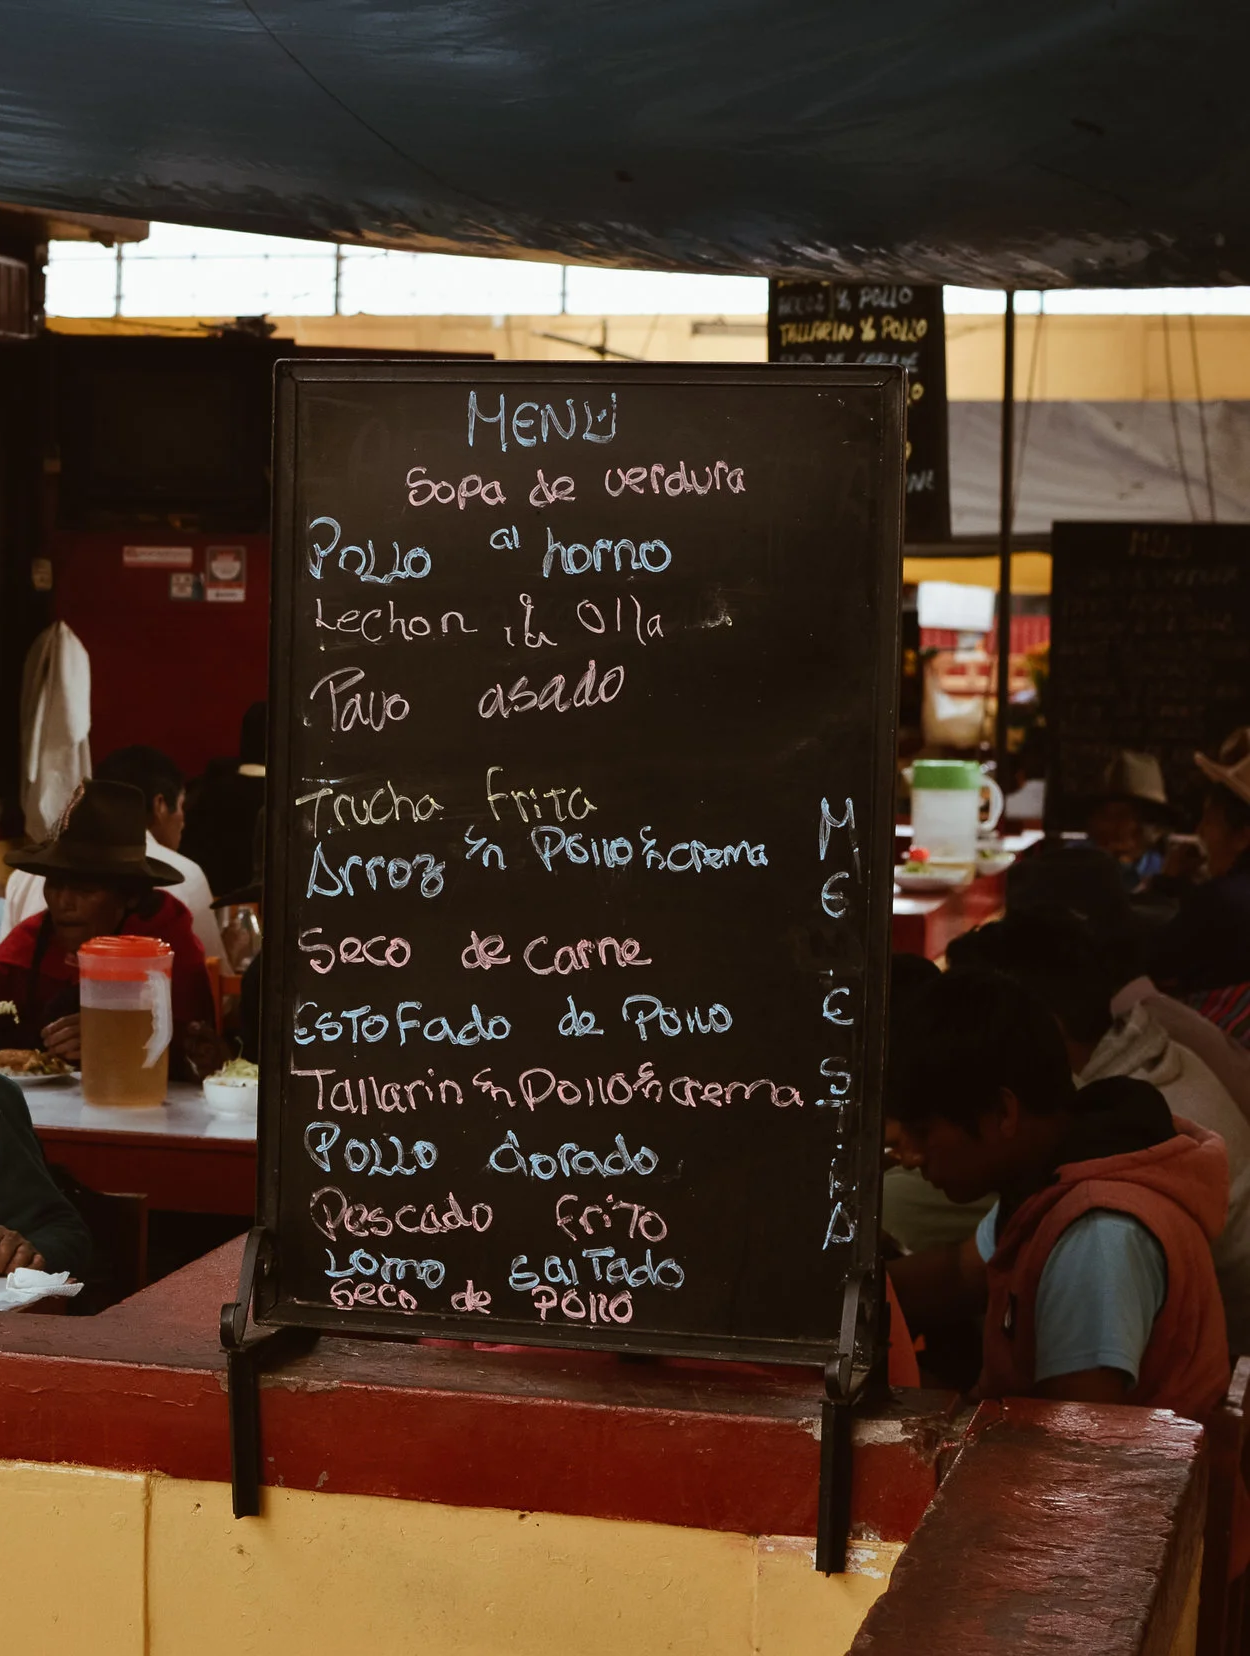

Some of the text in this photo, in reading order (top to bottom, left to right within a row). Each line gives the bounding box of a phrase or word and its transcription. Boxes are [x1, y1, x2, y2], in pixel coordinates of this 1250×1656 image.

[406, 466, 507, 511] Sopa
[297, 926, 412, 975] Seco
[327, 1280, 422, 1316] Seco
